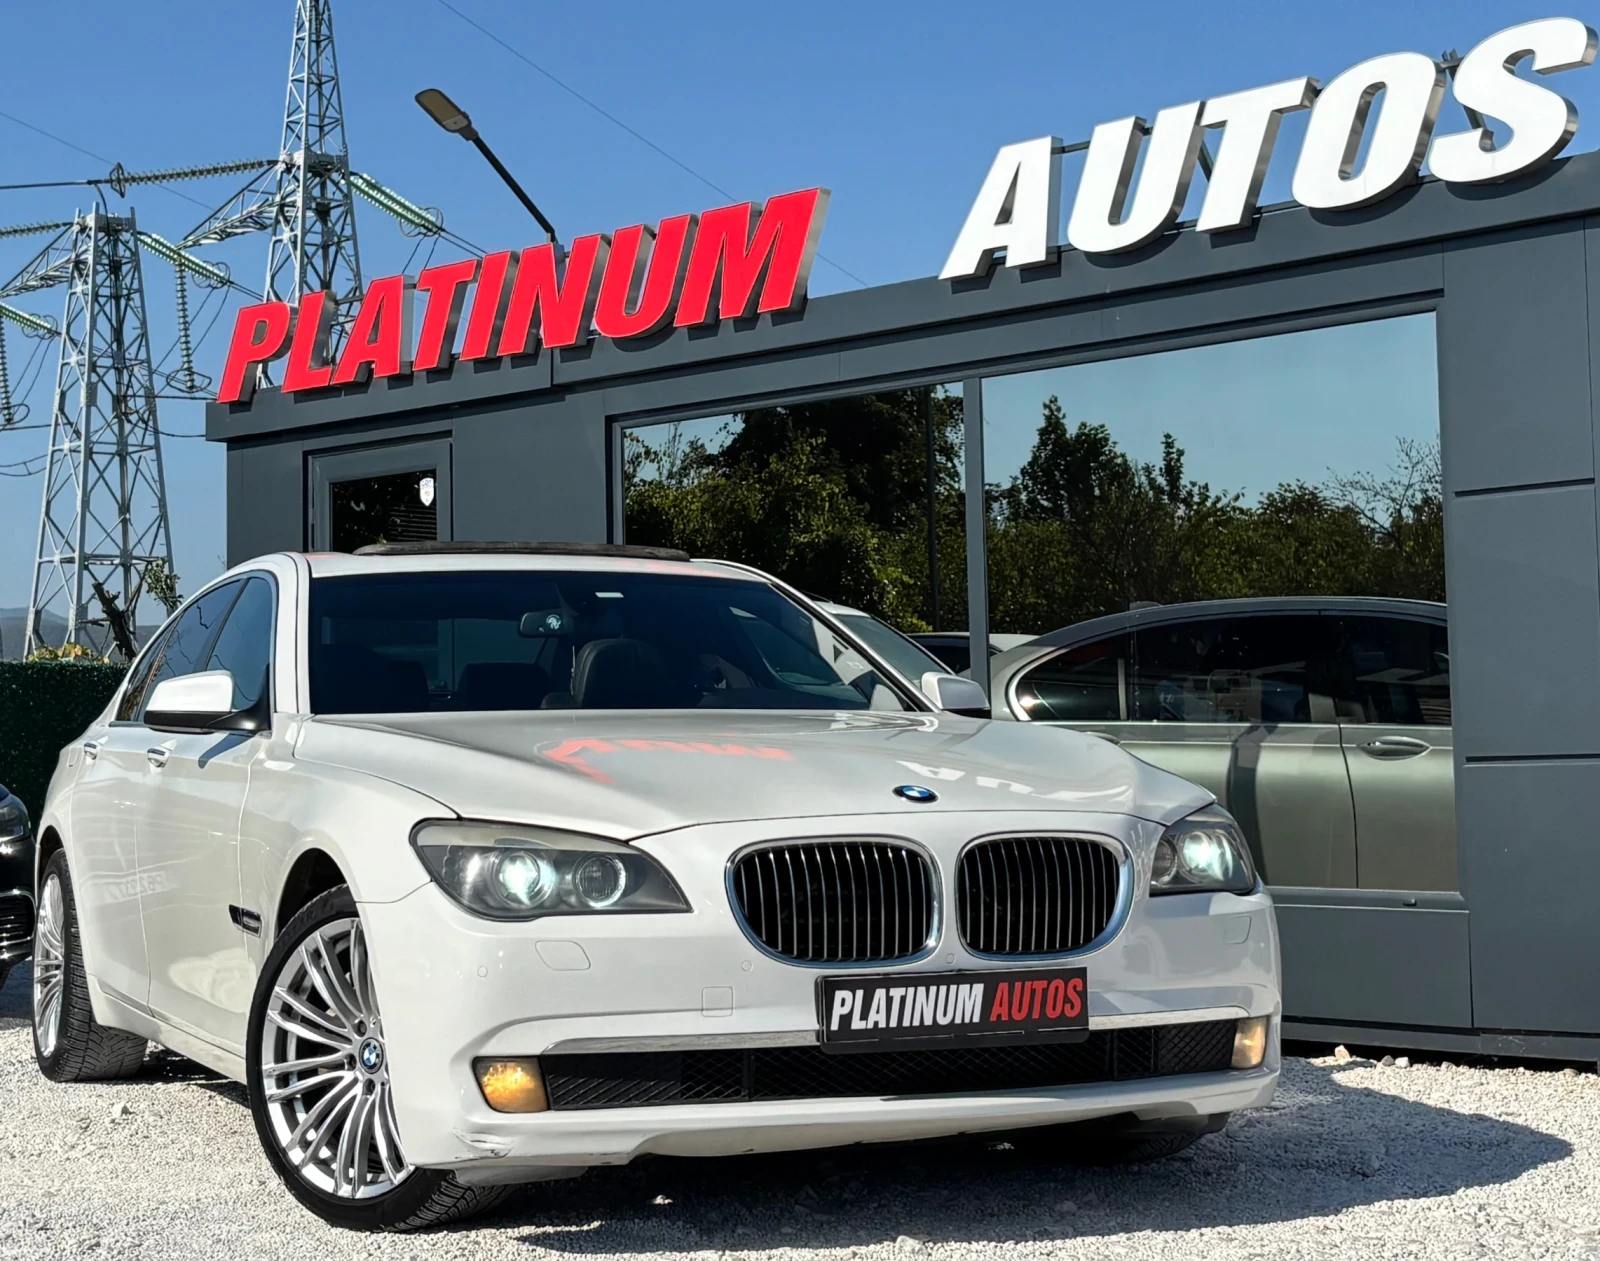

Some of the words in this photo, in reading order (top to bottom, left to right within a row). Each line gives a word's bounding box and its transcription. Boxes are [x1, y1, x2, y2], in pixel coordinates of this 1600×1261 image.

[217, 187, 830, 404] PLATINUM
[938, 17, 1597, 281] AUTOS
[830, 983, 985, 1031] PLATINUM
[989, 977, 1084, 1022] AUTOS
